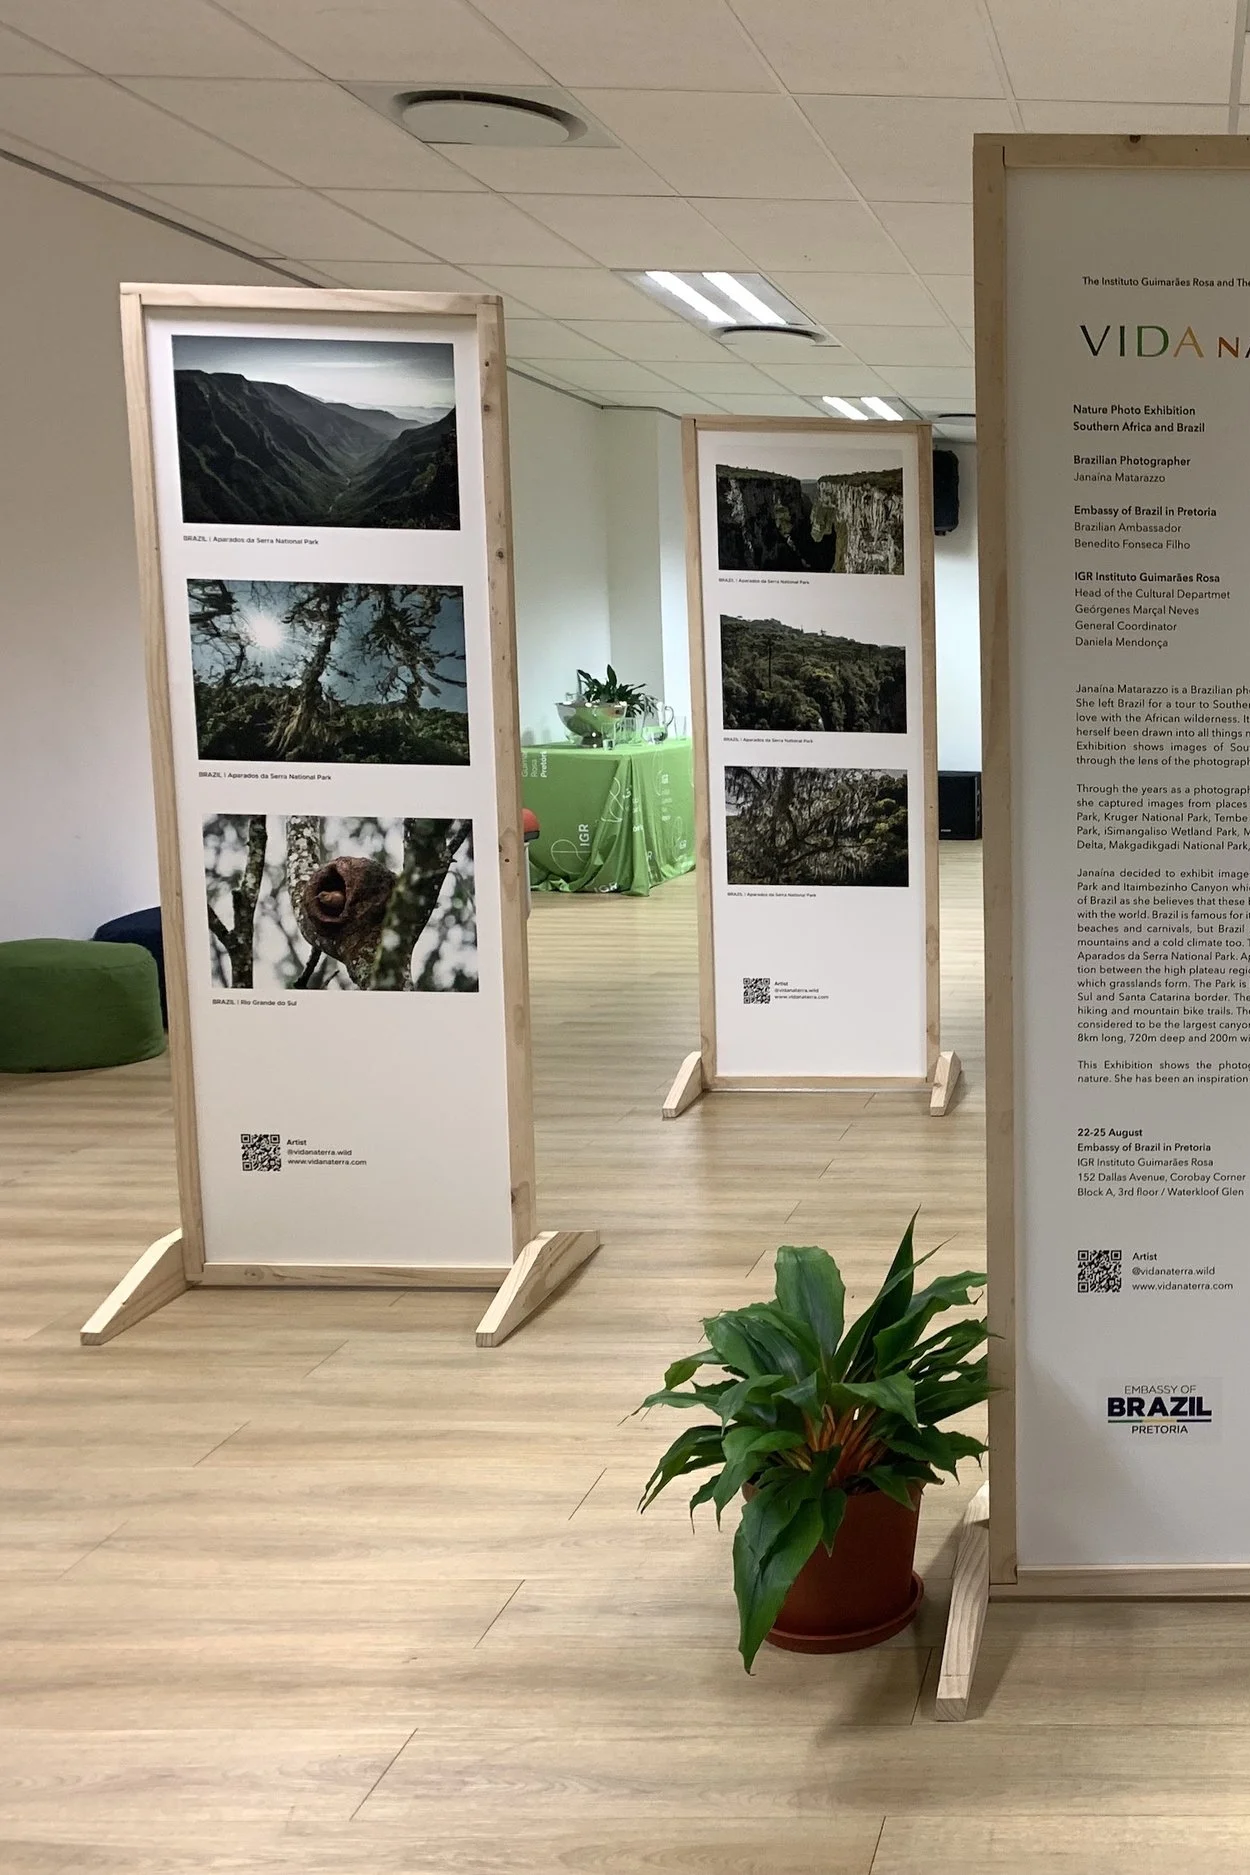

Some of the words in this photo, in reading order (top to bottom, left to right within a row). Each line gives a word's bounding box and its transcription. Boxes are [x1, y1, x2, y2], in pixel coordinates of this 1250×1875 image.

[1082, 275, 1099, 286] The
[1101, 276, 1139, 286] Instituto
[1140, 276, 1190, 286] Guimarães
[1192, 277, 1214, 287] Rosa
[1216, 277, 1234, 287] and
[1080, 324, 1205, 358] VIDA
[1073, 404, 1107, 414] Nature
[1110, 404, 1141, 414] Photo
[1144, 404, 1195, 415] Exhibition
[1073, 421, 1119, 431] Southern
[1121, 421, 1151, 432] Africa
[1154, 422, 1173, 432] and
[1176, 422, 1204, 432] Brazil
[1073, 455, 1116, 464] Brazilian
[1120, 455, 1190, 468] Photographer
[1073, 472, 1112, 482] Janaína
[1115, 472, 1165, 482] Matarazzo
[1074, 505, 1119, 517] Embassy
[1121, 505, 1132, 515] of
[1134, 505, 1162, 515] Brazil
[1165, 506, 1174, 516] in
[1177, 506, 1216, 516] Pretoria
[1074, 522, 1116, 532] Brazilian
[1118, 522, 1181, 532] Ambassador
[1074, 538, 1120, 548] Benedito
[1122, 538, 1163, 549] Fonseca
[1166, 539, 1190, 549] Filho
[1074, 571, 1093, 580] IGR
[1095, 571, 1136, 581] Instituto
[1139, 572, 1193, 582] Guimarães
[1196, 572, 1220, 582] Rosa
[1074, 588, 1101, 597] Head
[1104, 588, 1114, 598] of
[1116, 588, 1132, 598] the
[1135, 588, 1174, 598] Cultural
[1177, 588, 1230, 601] Departmet
[1074, 604, 1130, 616] Geórgenes
[1132, 604, 1165, 616] Marçal
[1168, 605, 1199, 615] Neves
[1074, 620, 1114, 630] General
[1116, 620, 1176, 631] Coordinator
[1075, 636, 1112, 646] Daniela
[1115, 636, 1168, 649] Mendonça
[1075, 683, 1114, 695] Janaína
[1117, 683, 1168, 694] Matarazzo
[1171, 684, 1179, 694] is
[1181, 686, 1187, 694] a
[1190, 684, 1232, 694] Brazilian
[579, 824, 589, 847] IGR
[1077, 1032, 1098, 1042] 8km
[1101, 1033, 1126, 1044] long,
[1129, 1033, 1156, 1042] 720m
[1159, 1033, 1185, 1044] deep
[1188, 1033, 1206, 1042] and
[1209, 1033, 1237, 1042] 200m
[1077, 1128, 1105, 1136] 22-25
[1108, 1128, 1142, 1139] August
[1078, 1172, 1095, 1182] 152
[1098, 1172, 1126, 1181] Dallas
[1128, 1172, 1167, 1182] Avenue,
[1169, 1172, 1210, 1183] Corobay
[1213, 1172, 1245, 1181] Corner
[1132, 1252, 1157, 1261] Artist
[1131, 1266, 1215, 1275] @vidanaterra.wild
[1132, 1281, 1233, 1290] www.vidanaterra.com
[1124, 1384, 1178, 1395] EMBASSY
[1180, 1384, 1196, 1394] OF
[1107, 1396, 1212, 1417] BRAZIL
[1131, 1424, 1188, 1434] PRETORIA
